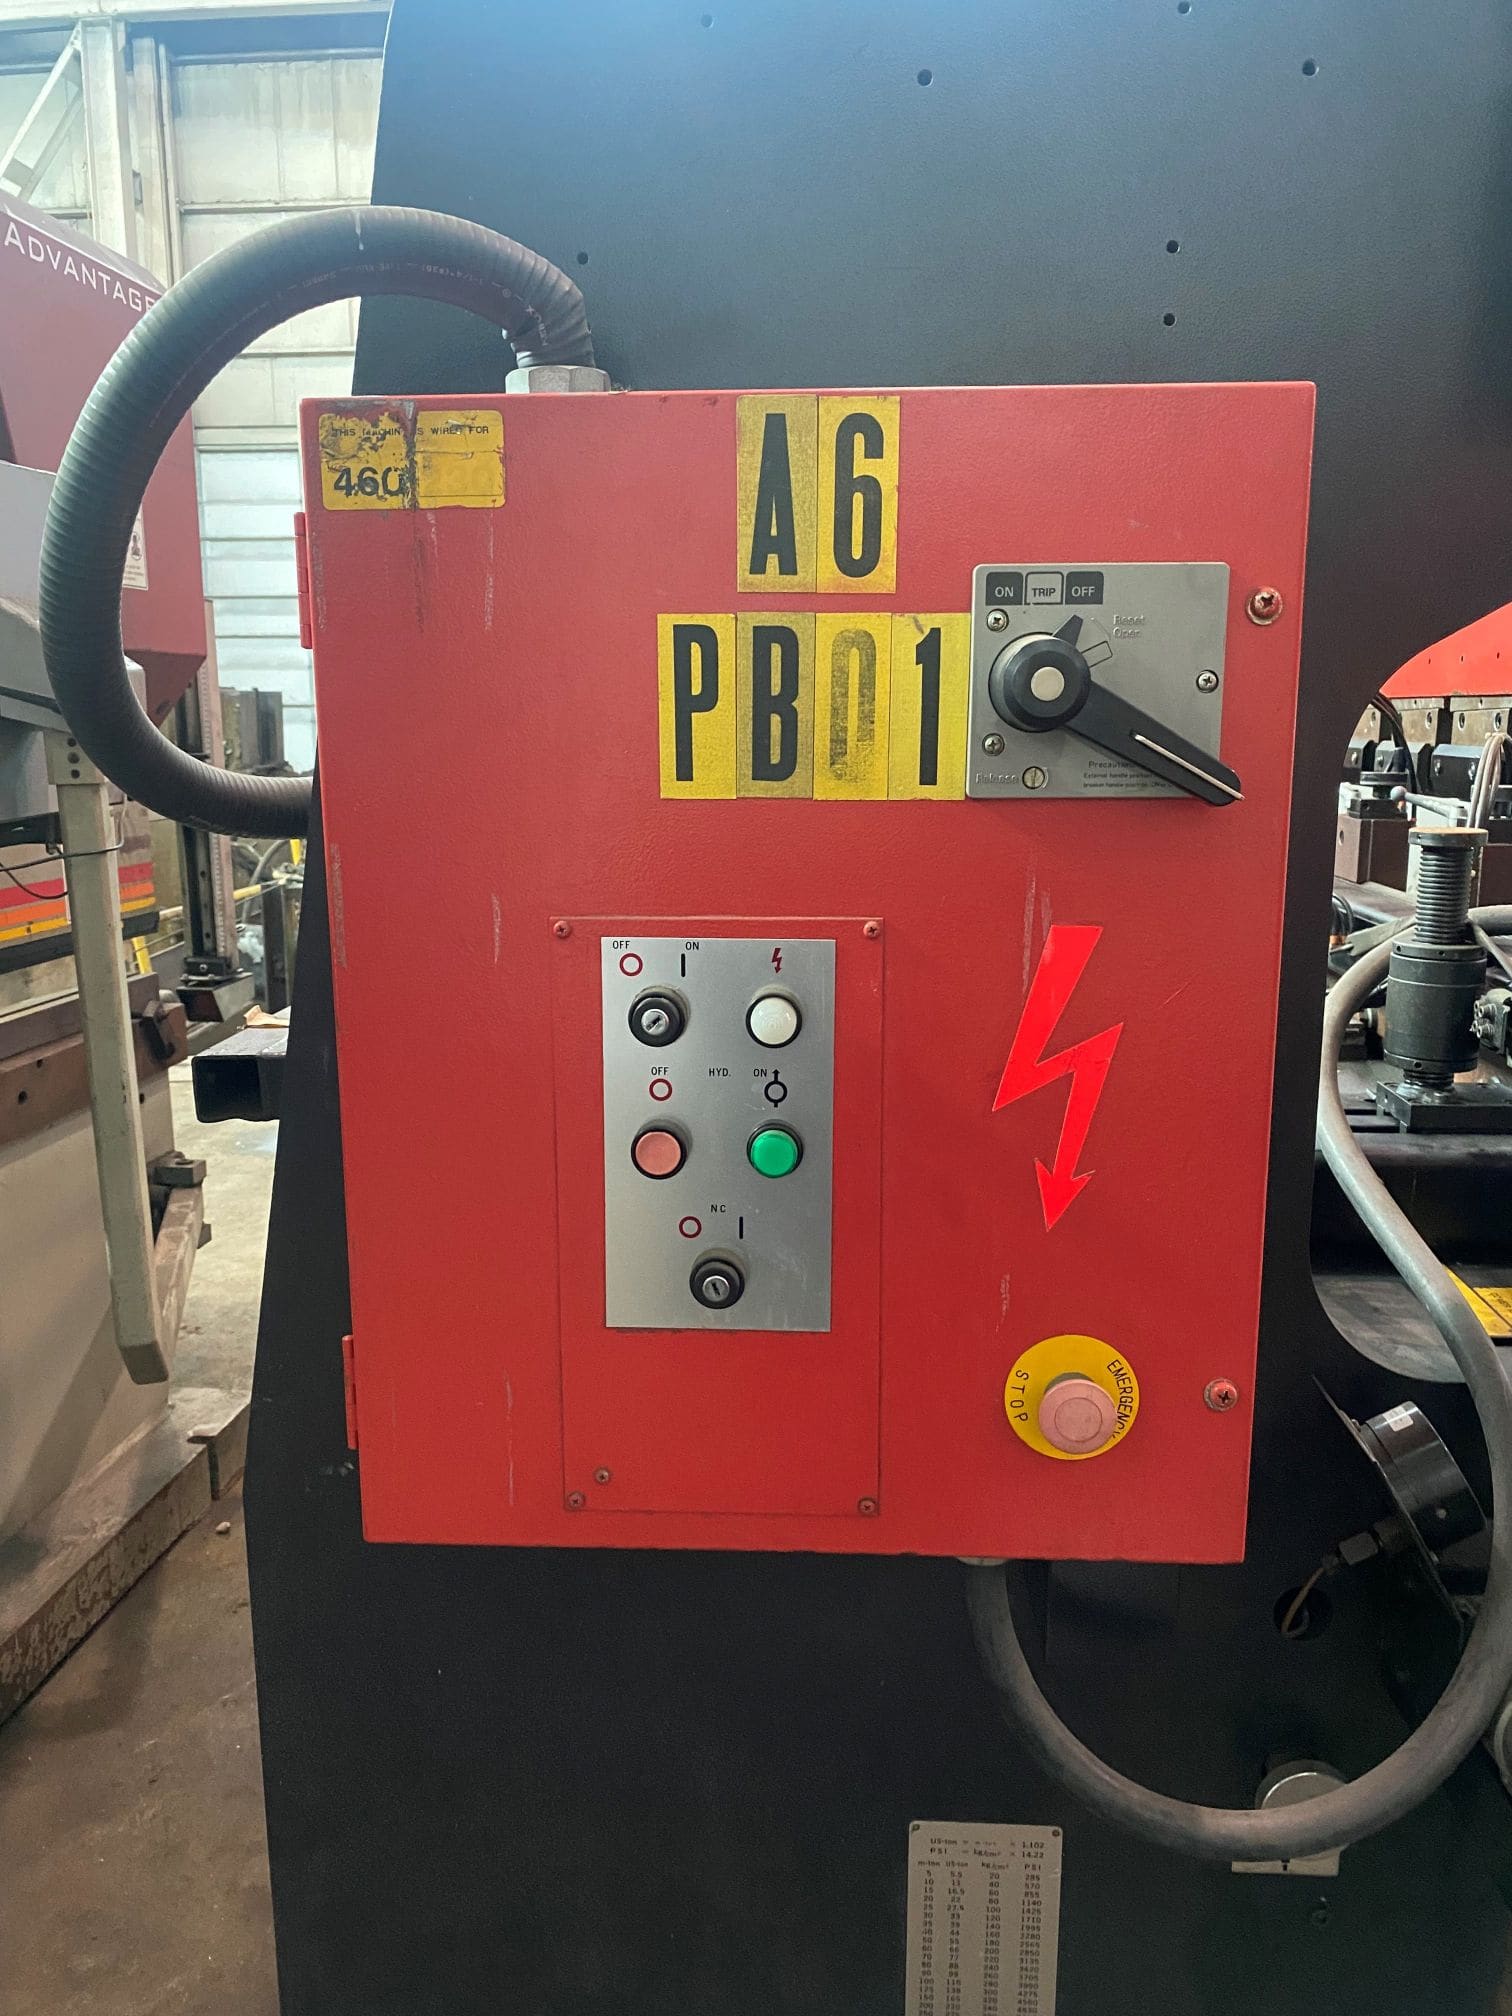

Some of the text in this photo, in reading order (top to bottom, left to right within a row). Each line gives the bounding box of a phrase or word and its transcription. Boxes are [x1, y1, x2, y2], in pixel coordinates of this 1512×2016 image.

[468, 425, 489, 434] FOR
[749, 412, 884, 578] A6
[994, 586, 1014, 598] ON
[1031, 587, 1056, 598] TRIP
[1071, 586, 1096, 597] OFF
[612, 940, 630, 950] OFF
[685, 941, 699, 951] ON
[651, 1066, 669, 1076] OFF
[708, 1067, 731, 1077] HYD.
[753, 1068, 767, 1077] ON
[1010, 1369, 1029, 1422] STOP
[1022, 1851, 1044, 1859] 14.22
[990, 1872, 999, 1880] 20
[925, 1878, 934, 1886] 10
[987, 1906, 1000, 1914] 100
[987, 1914, 1000, 1922] 120
[1022, 1916, 1041, 1924] 1710
[986, 1922, 1000, 1930] 140
[985, 1947, 999, 1955] 200
